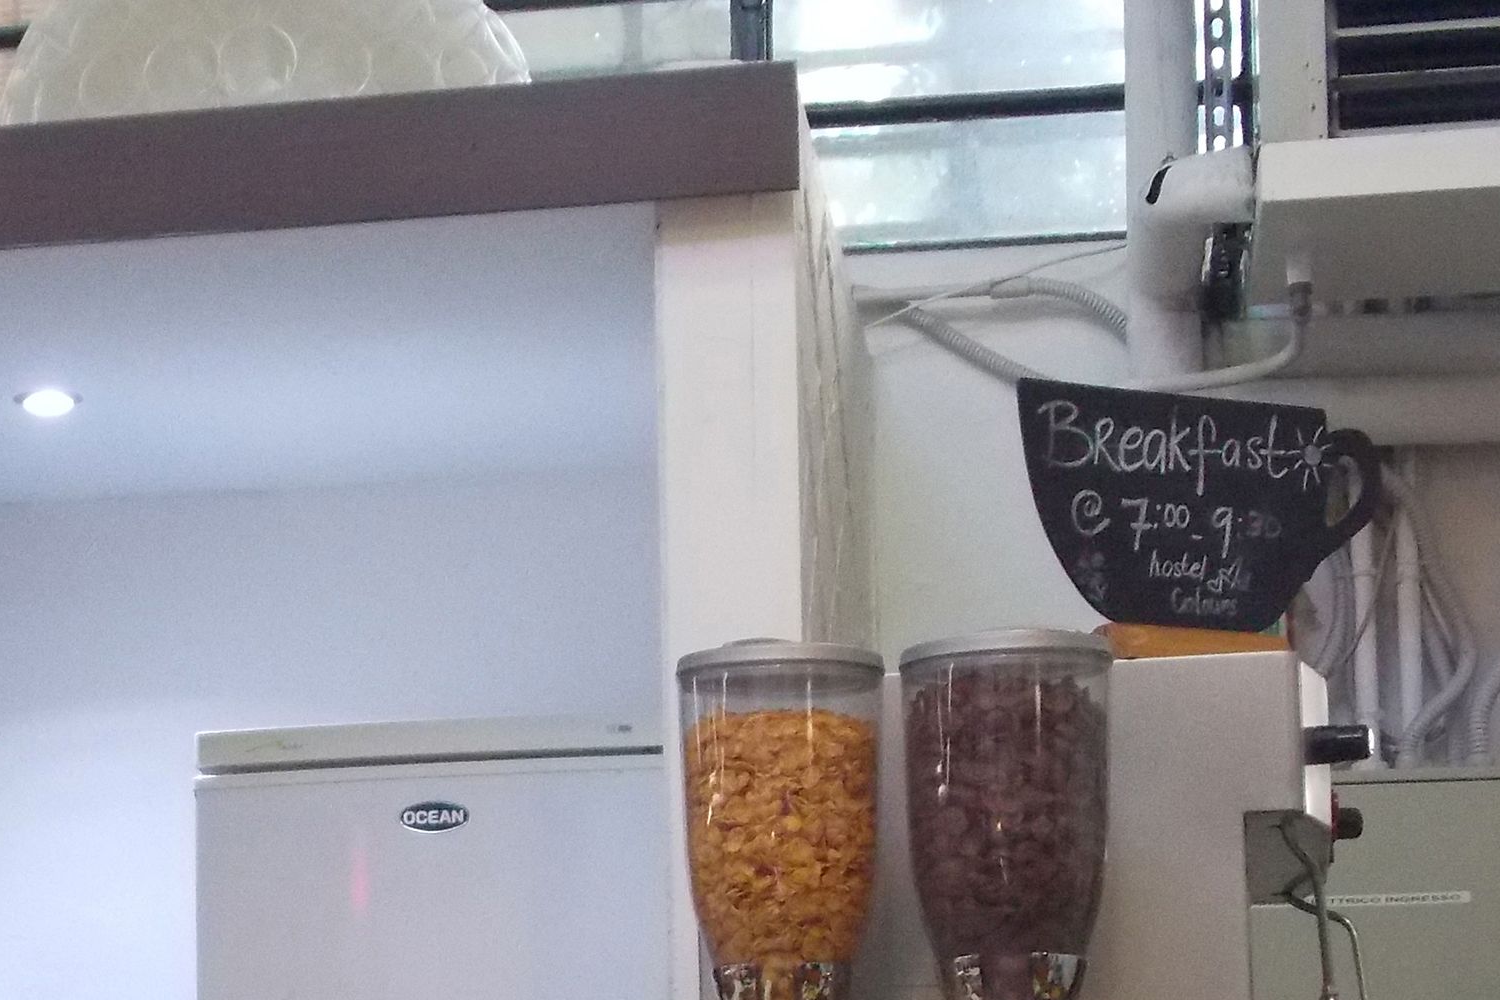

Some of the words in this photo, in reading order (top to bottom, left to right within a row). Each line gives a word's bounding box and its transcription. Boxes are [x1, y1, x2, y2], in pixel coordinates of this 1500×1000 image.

[1037, 399, 1289, 497] Breakfast
[1071, 489, 1112, 537] @
[1120, 496, 1191, 552] 7:00
[1148, 548, 1208, 583] hostel
[403, 809, 464, 825] OCEAN
